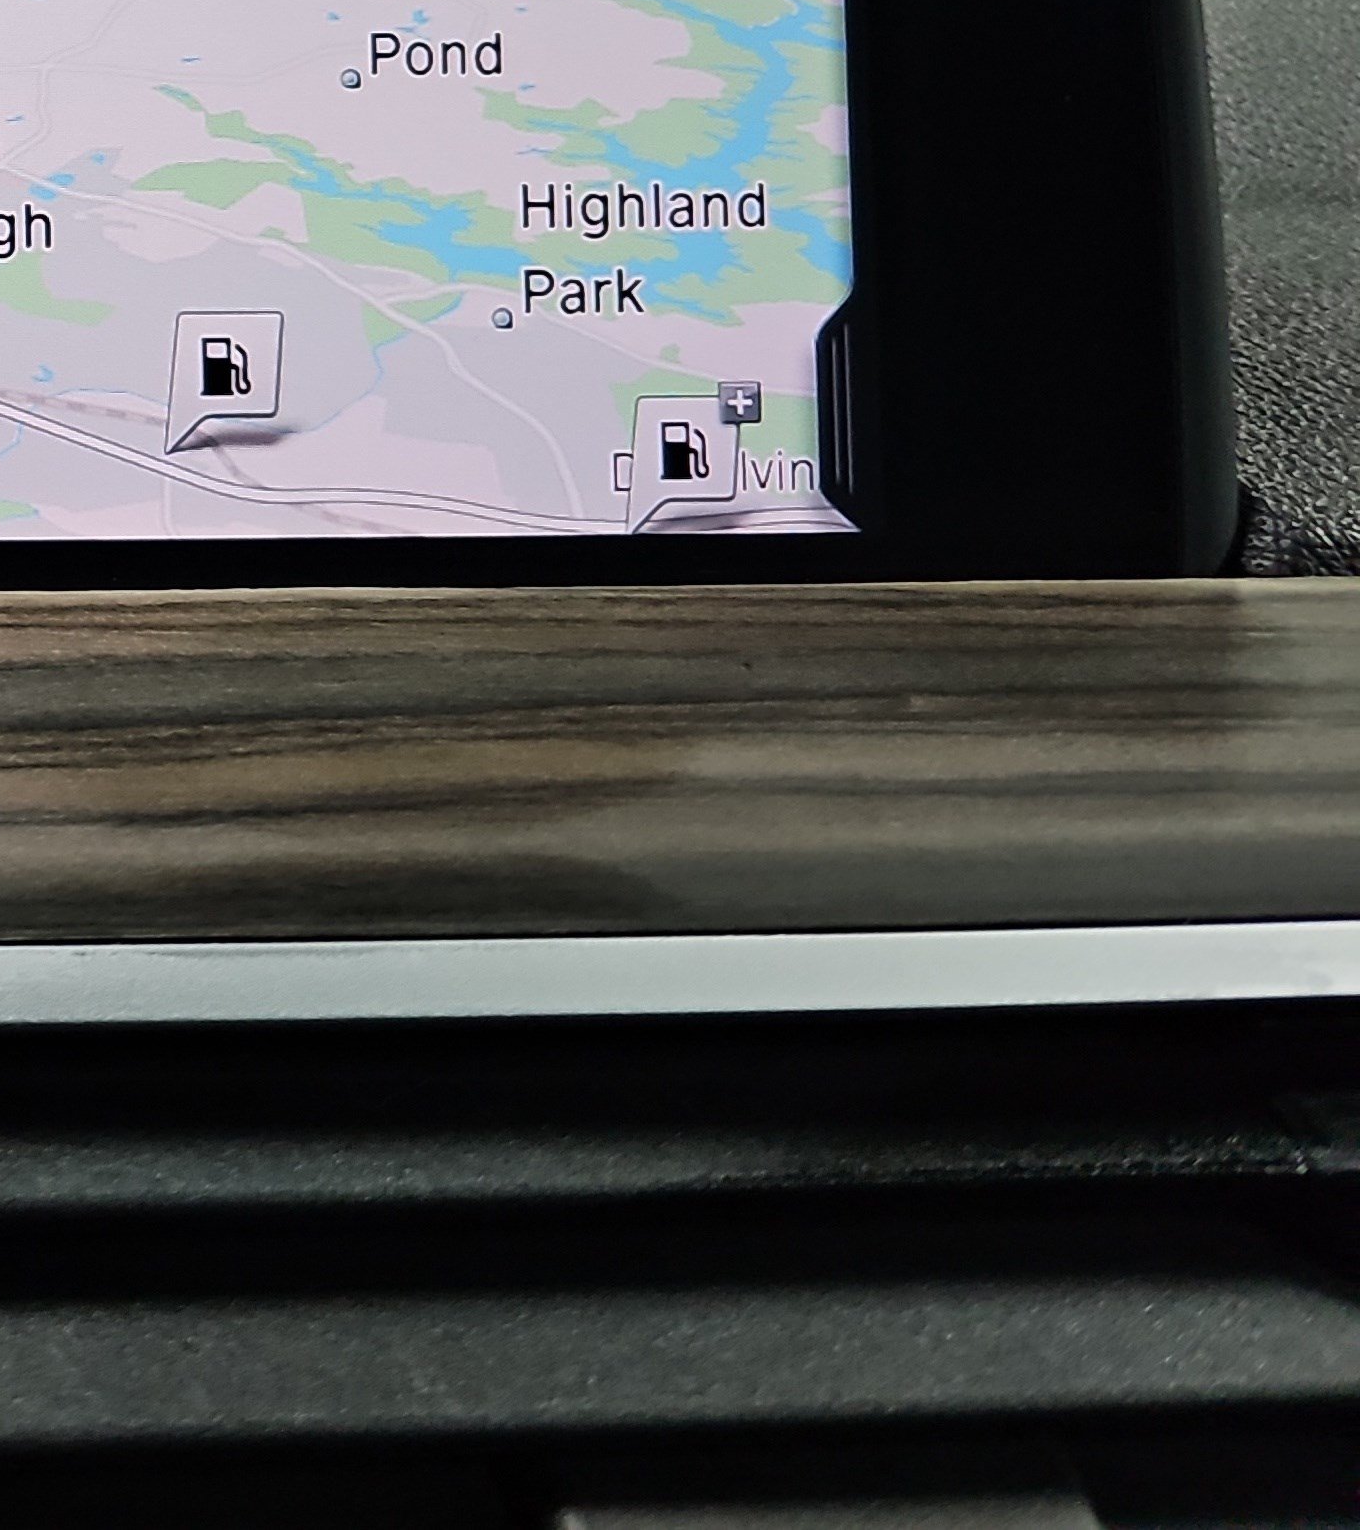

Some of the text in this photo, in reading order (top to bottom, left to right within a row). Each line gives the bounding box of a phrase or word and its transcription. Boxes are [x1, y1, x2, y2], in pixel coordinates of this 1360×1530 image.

[371, 31, 503, 76] Pond
[521, 183, 766, 240] Highland
[523, 268, 644, 314] Park
